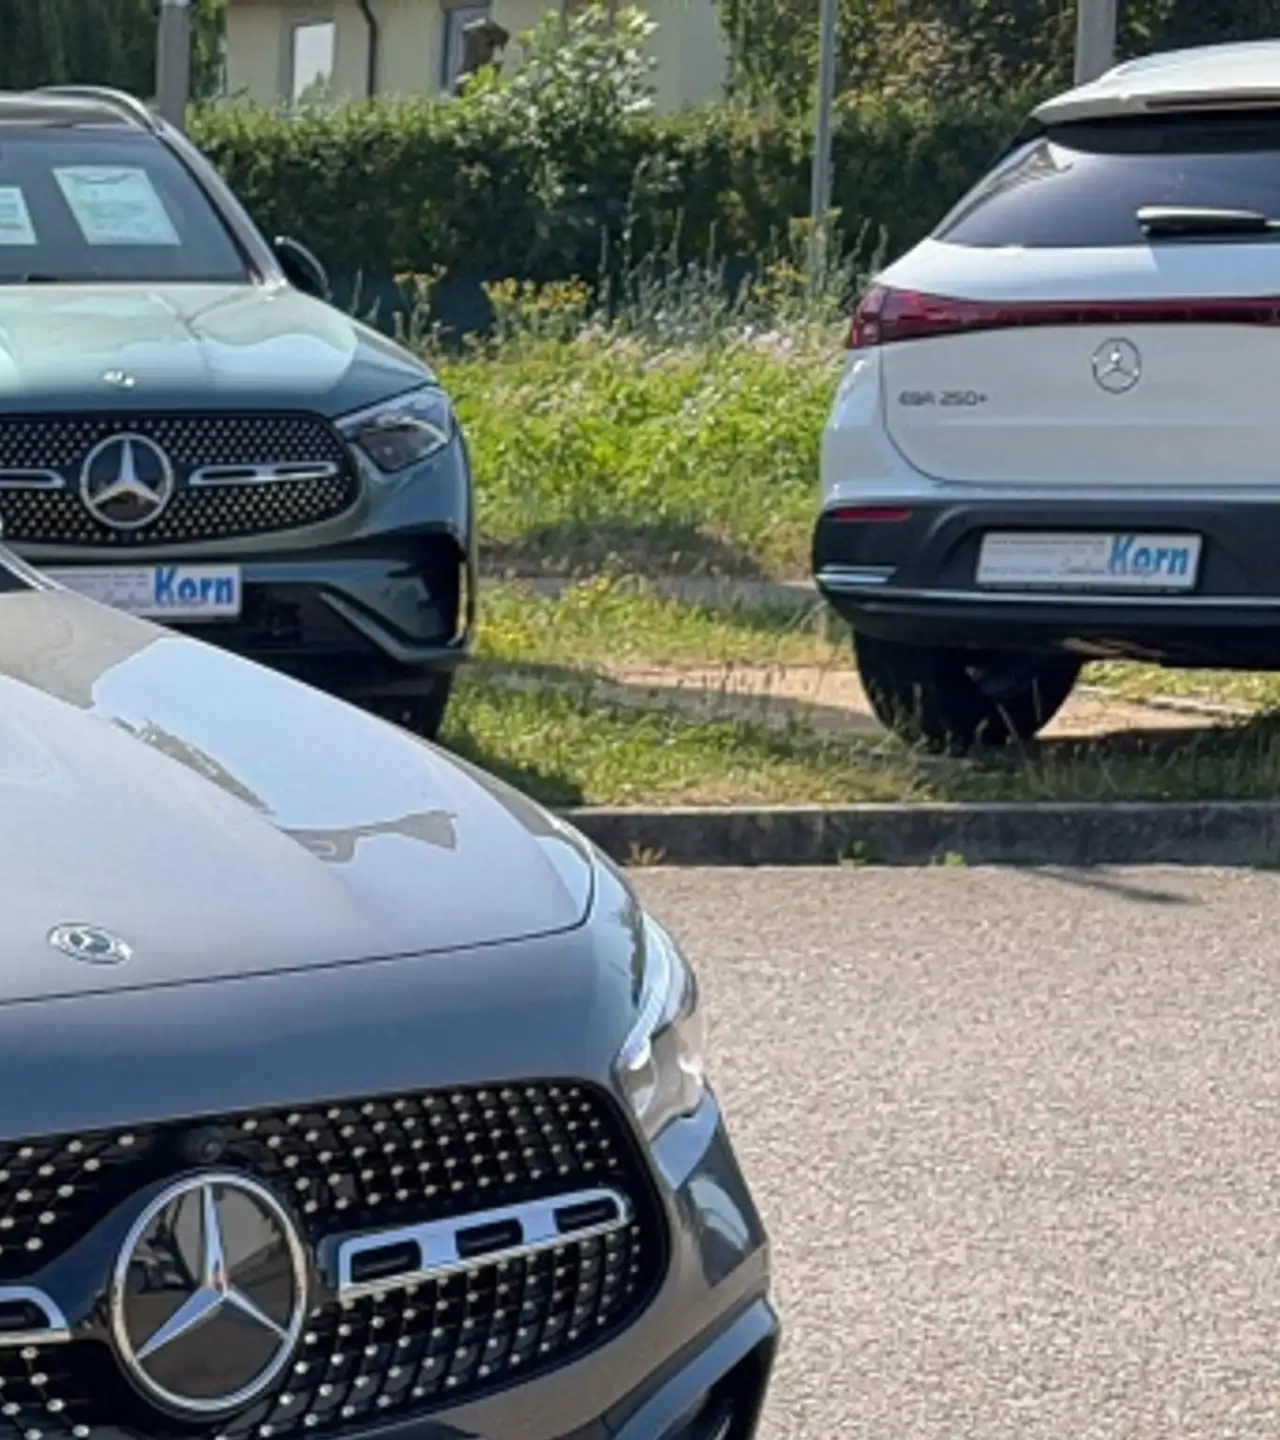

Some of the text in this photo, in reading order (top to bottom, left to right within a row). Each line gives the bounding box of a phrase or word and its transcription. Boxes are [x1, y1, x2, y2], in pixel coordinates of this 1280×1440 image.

[939, 389, 989, 407] 250+
[1106, 534, 1189, 577] Korn
[154, 566, 234, 605] Korn
